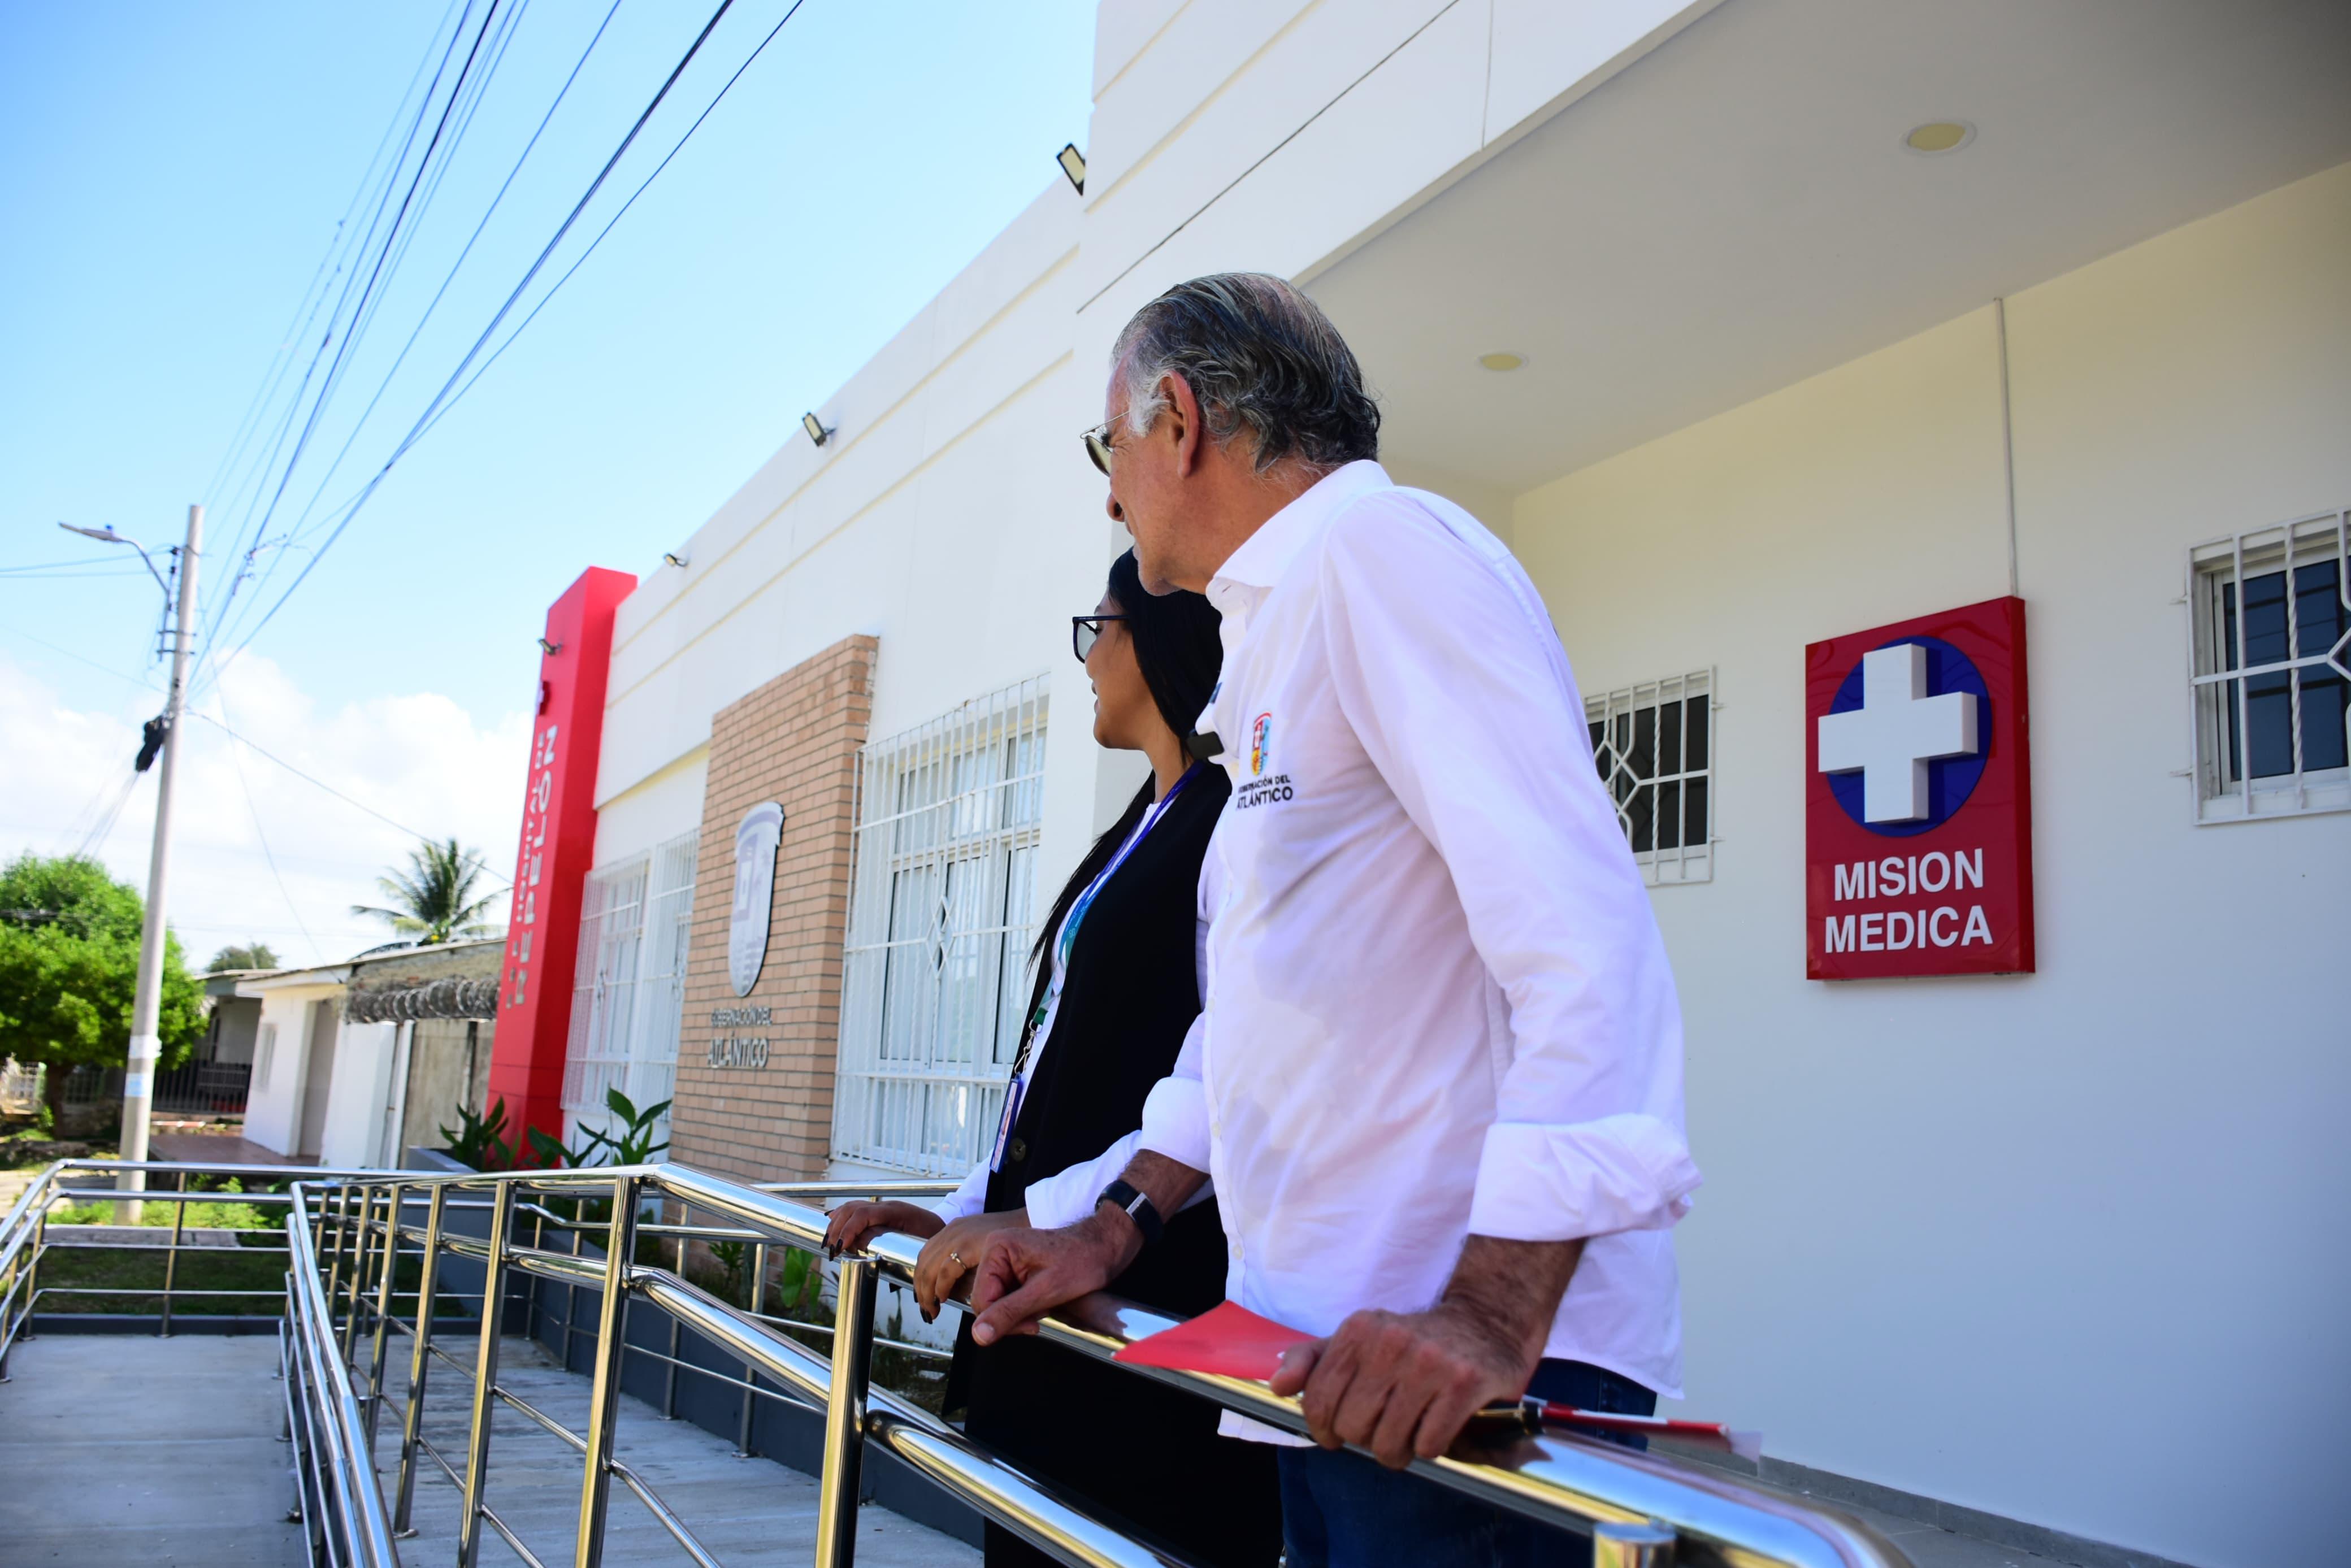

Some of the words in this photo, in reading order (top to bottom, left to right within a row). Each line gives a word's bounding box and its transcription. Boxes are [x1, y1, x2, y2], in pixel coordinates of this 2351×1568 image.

[1275, 774, 1291, 785] DEL
[516, 776, 540, 922] HOSPITAL
[535, 731, 544, 770] DE
[1834, 848, 1983, 901] MISION
[1825, 905, 1993, 953] MEDICA
[708, 1031, 769, 1069] ATLÁNTICO
